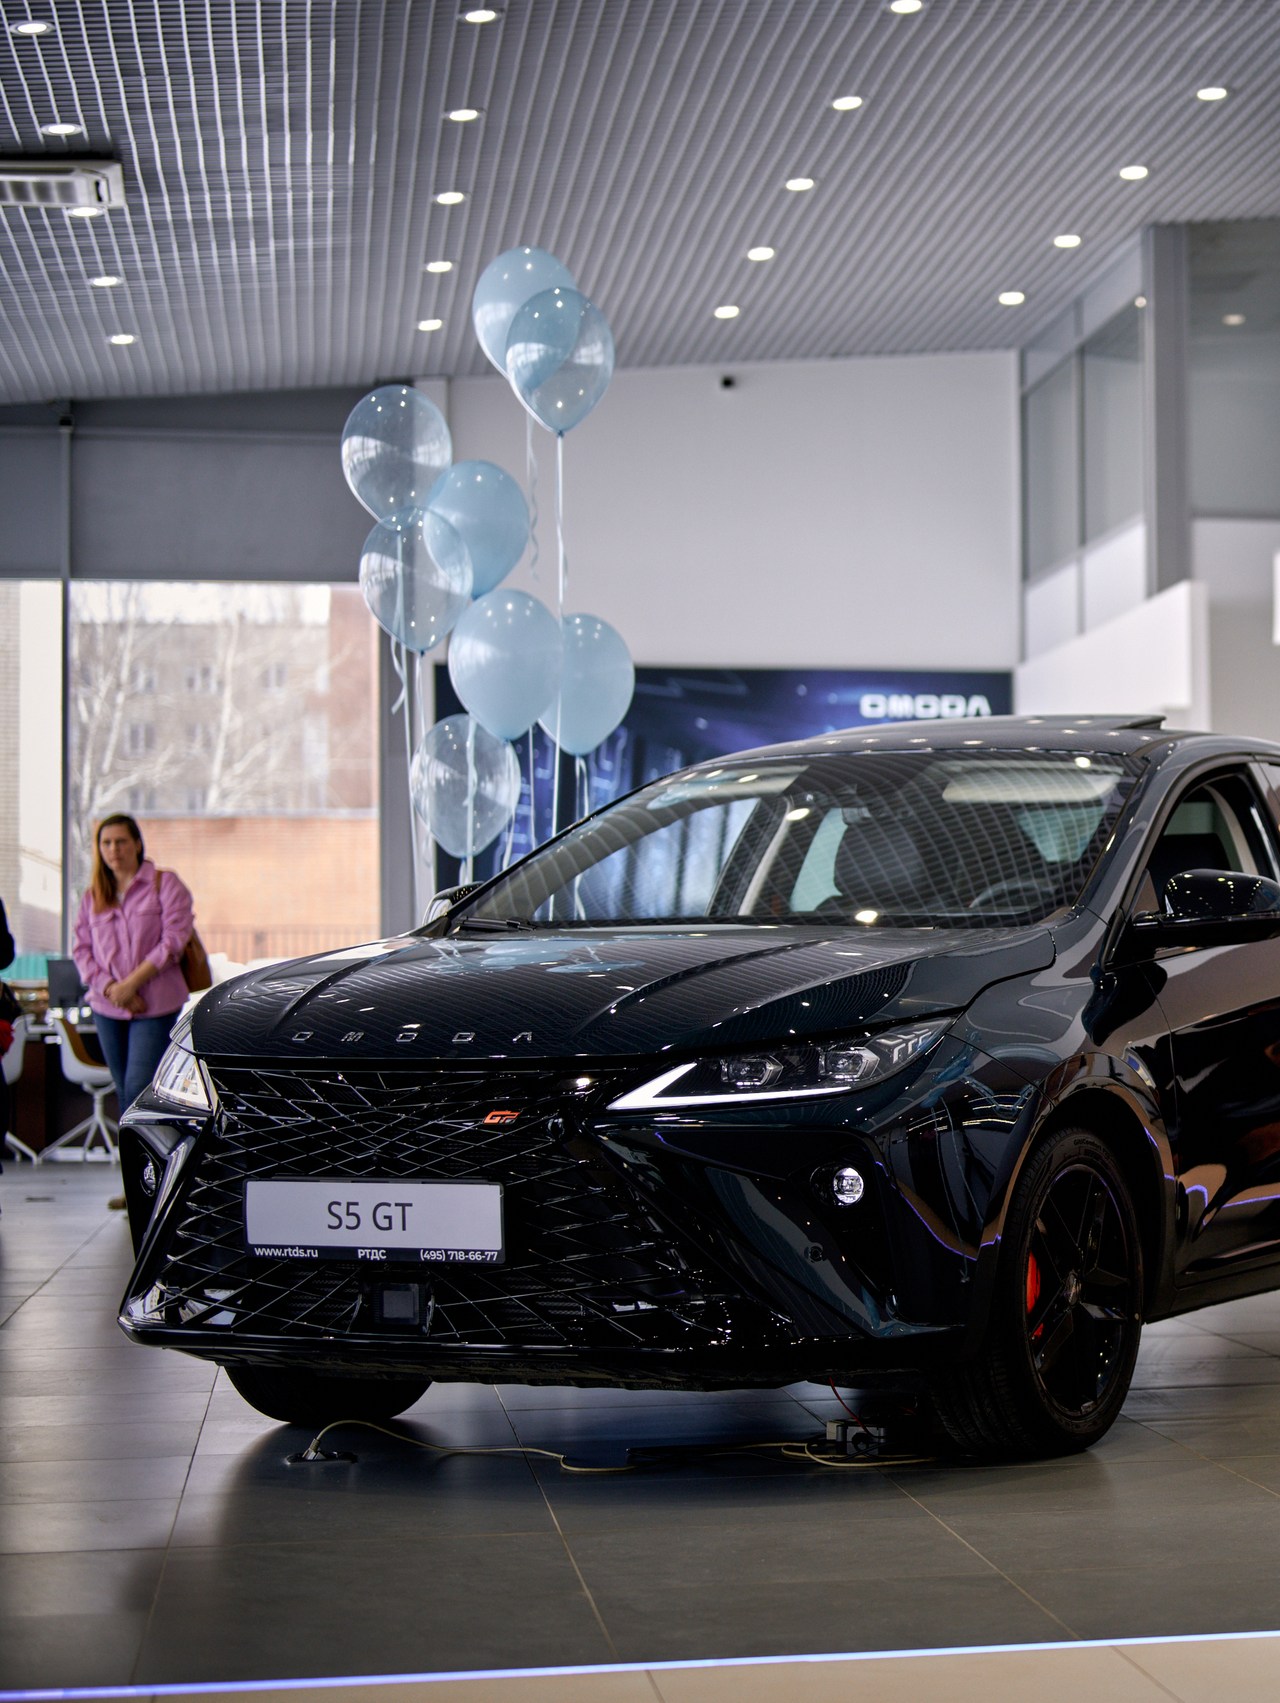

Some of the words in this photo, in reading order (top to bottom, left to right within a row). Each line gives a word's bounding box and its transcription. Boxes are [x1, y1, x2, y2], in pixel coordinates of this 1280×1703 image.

[859, 693, 992, 719] OMODA
[292, 1031, 533, 1043] OMODA
[483, 1110, 520, 1124] GT
[327, 1201, 361, 1230] S5
[372, 1201, 413, 1232] GT
[254, 1246, 319, 1258] www.rtds.ru
[358, 1249, 387, 1261] РТДС
[420, 1249, 446, 1261] (495)
[448, 1250, 498, 1262] 718-66-77
